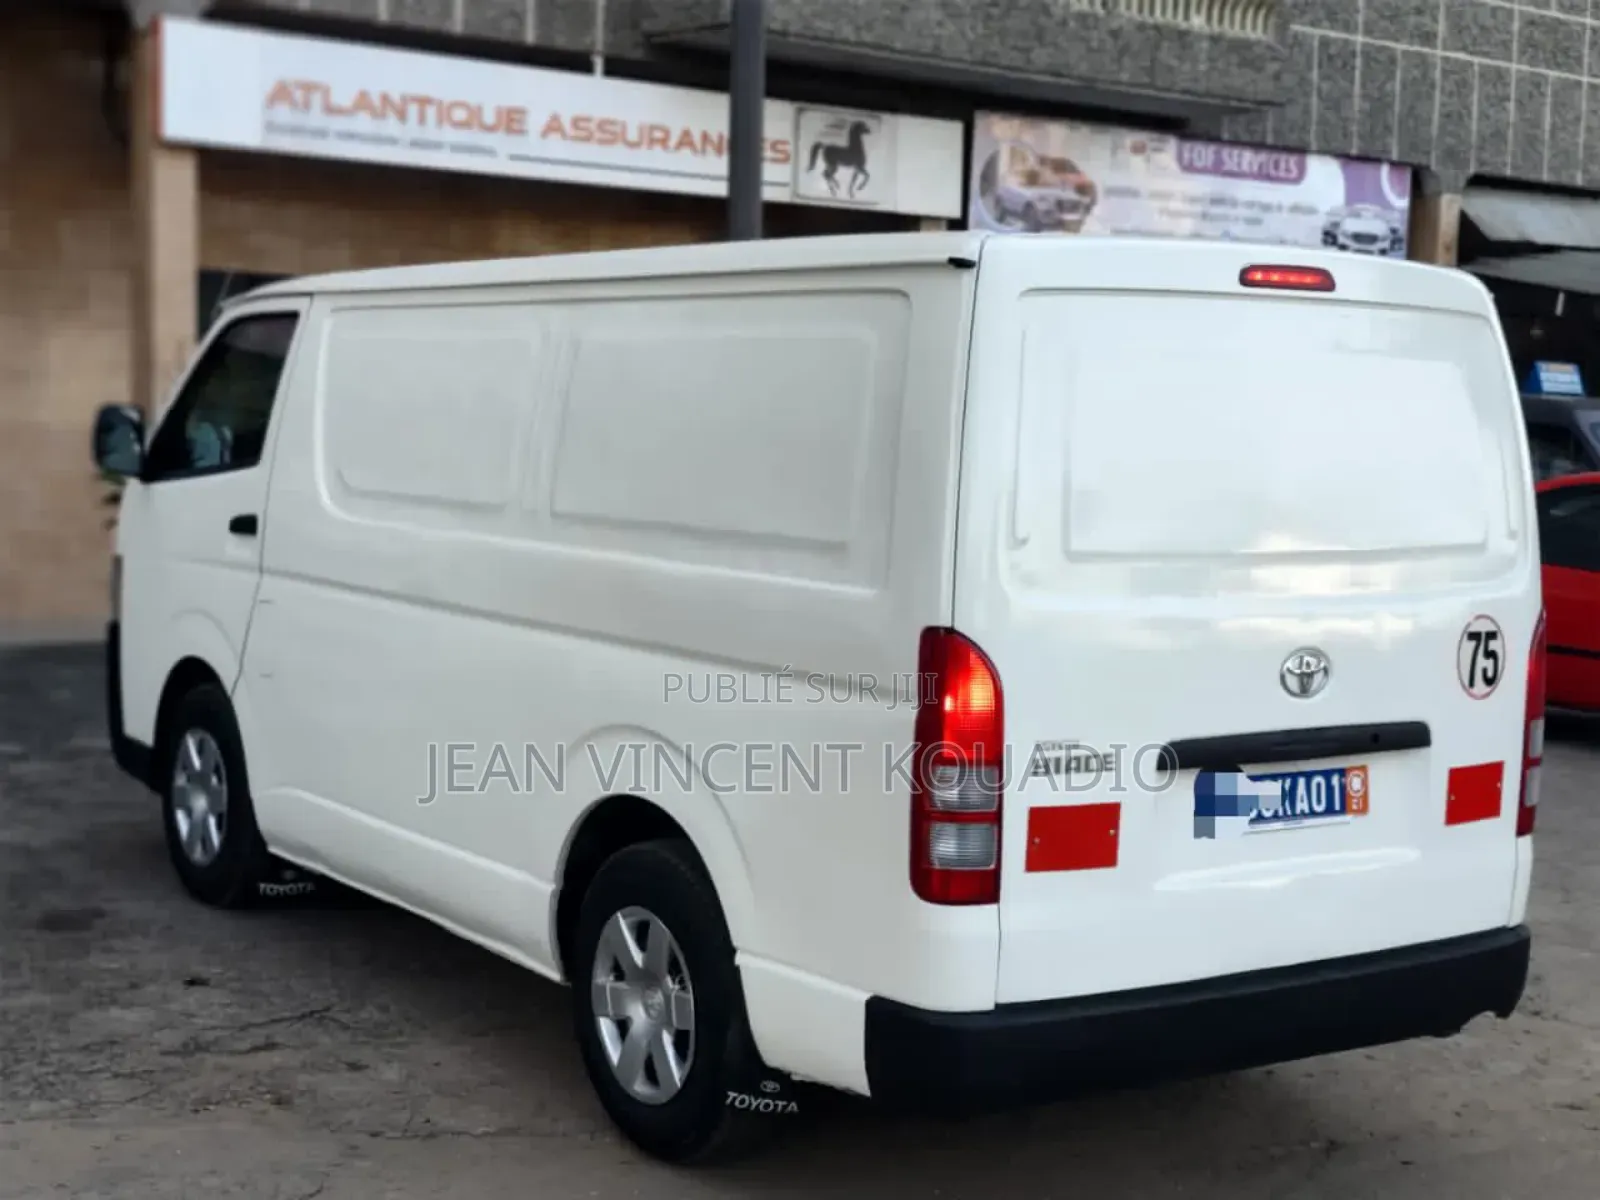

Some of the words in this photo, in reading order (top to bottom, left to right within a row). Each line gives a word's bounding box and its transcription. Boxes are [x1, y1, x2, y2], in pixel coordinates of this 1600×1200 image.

[265, 78, 530, 136] ATLANTIQUE
[540, 112, 793, 166] ASSURANS
[1466, 630, 1499, 689] 75
[258, 881, 317, 896] TOYOTA
[725, 1091, 800, 1113] TOYOTA
